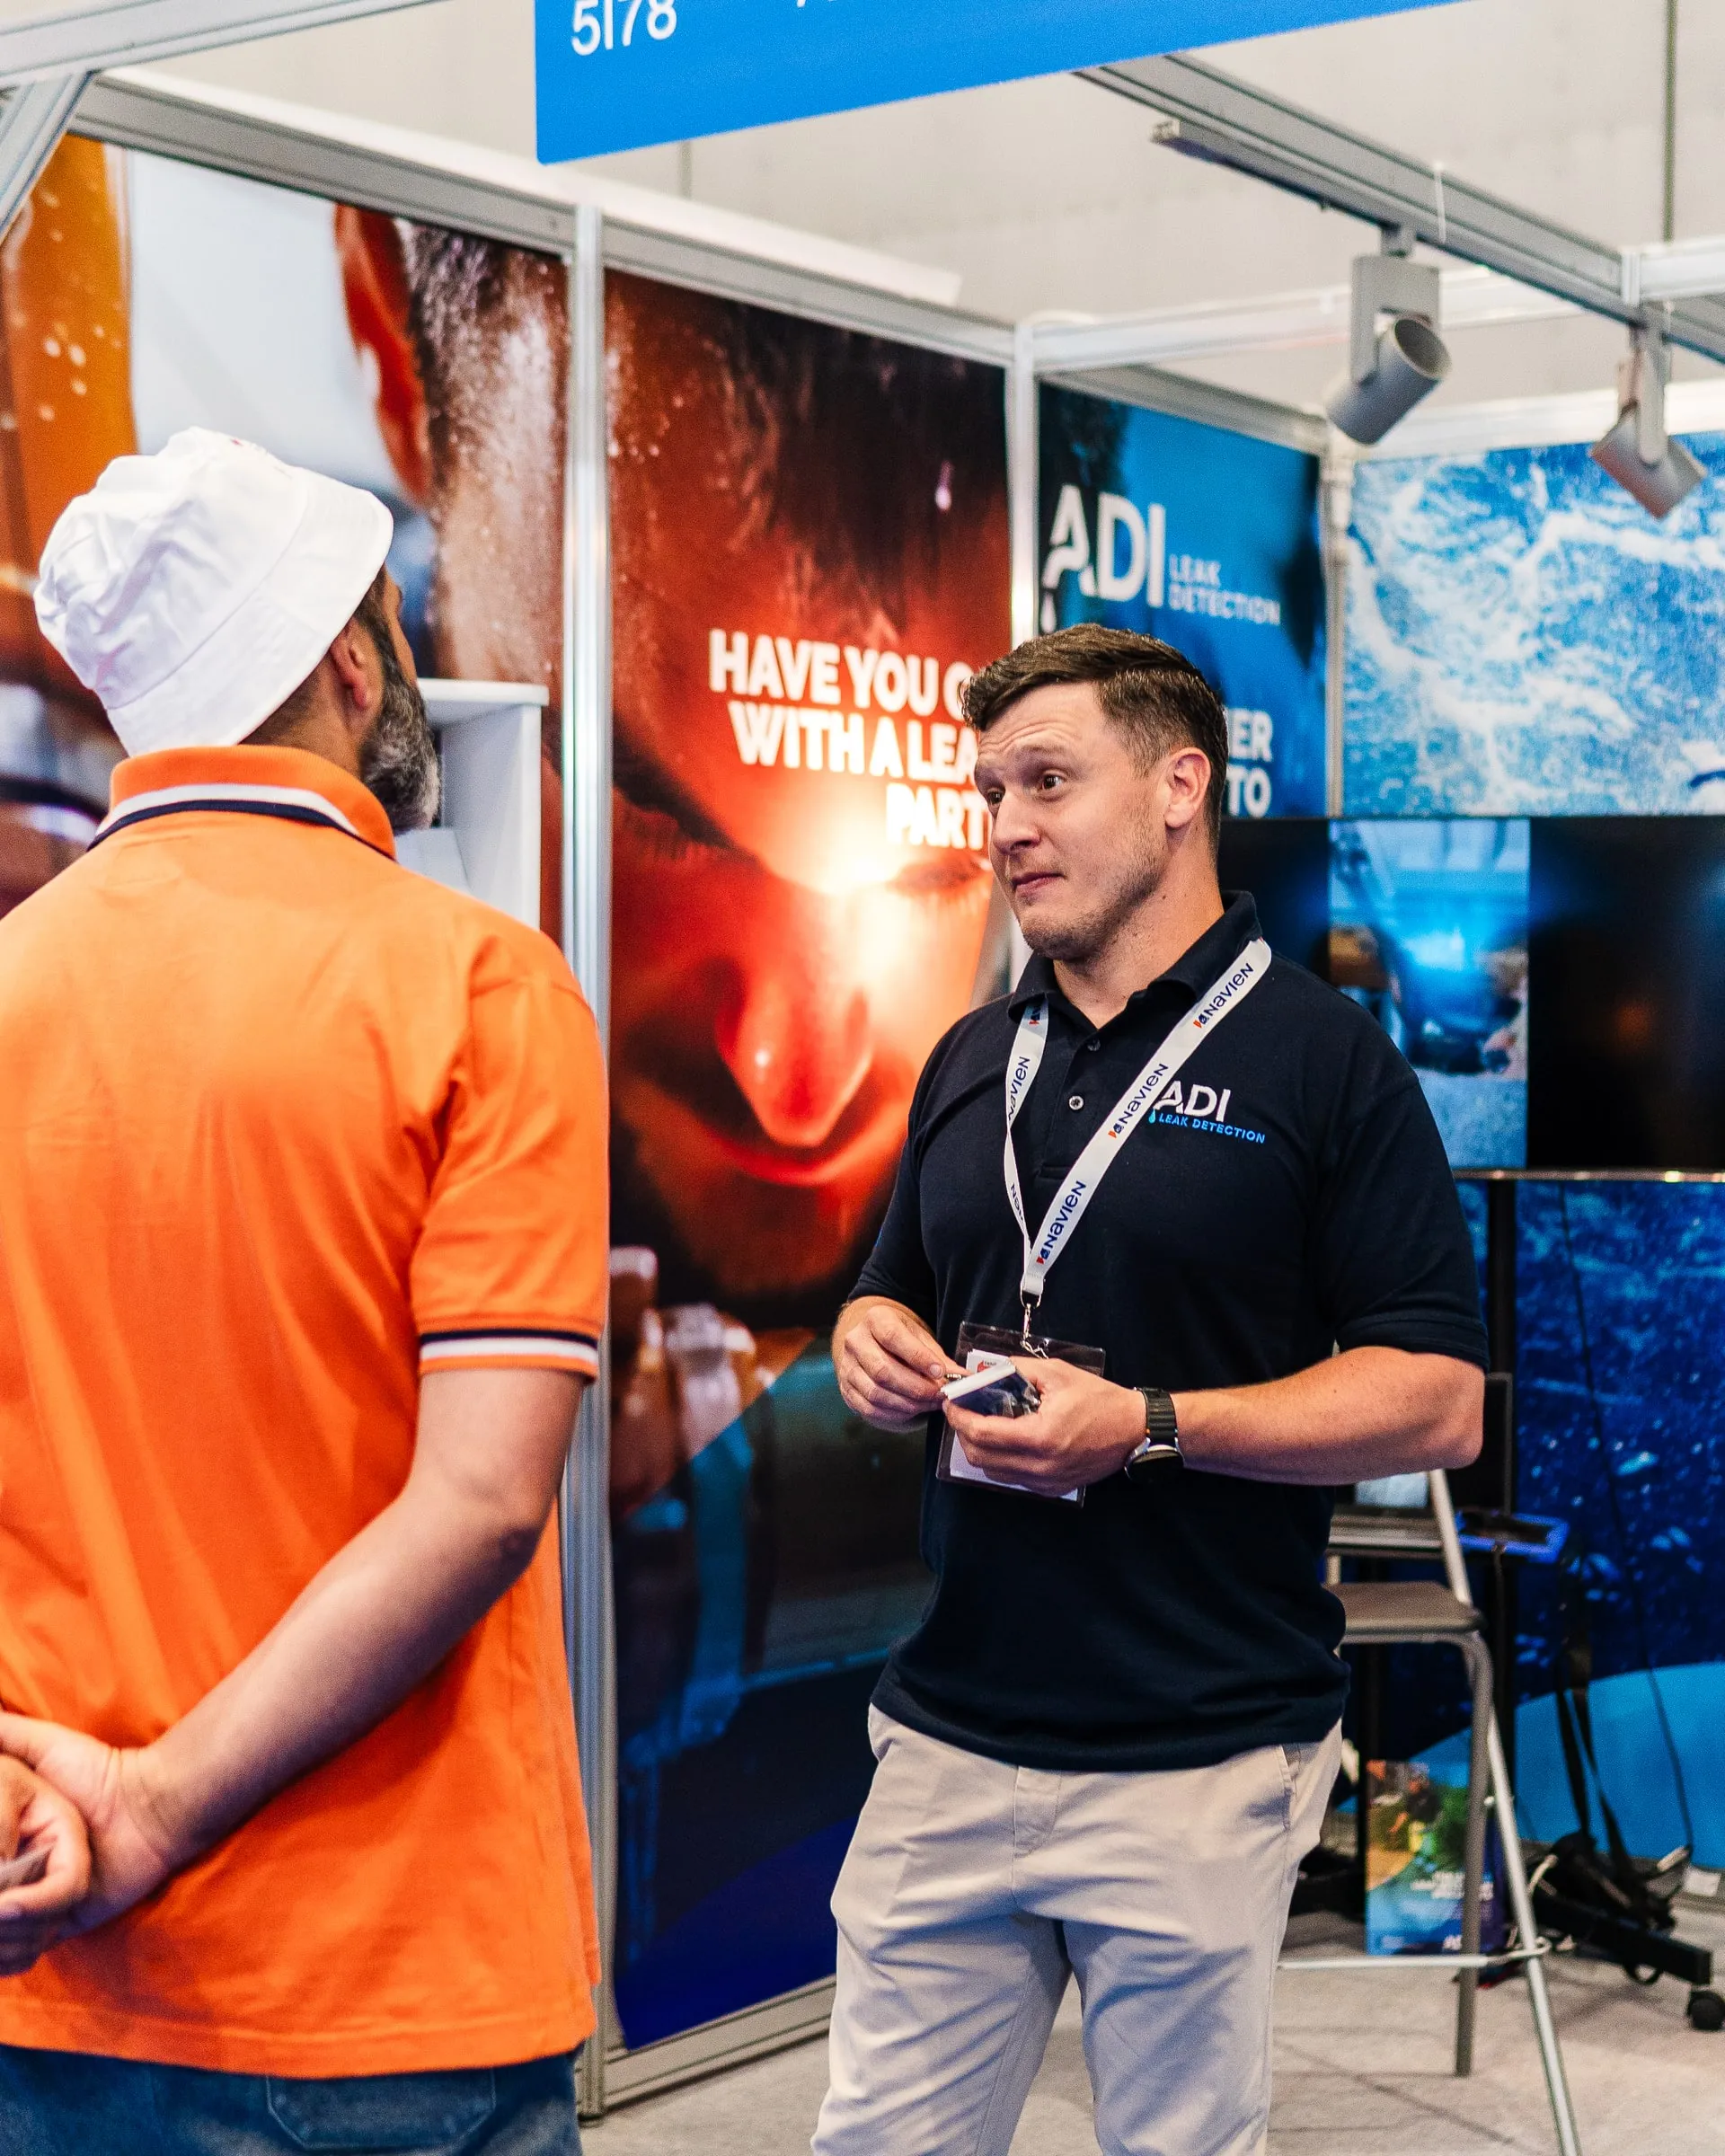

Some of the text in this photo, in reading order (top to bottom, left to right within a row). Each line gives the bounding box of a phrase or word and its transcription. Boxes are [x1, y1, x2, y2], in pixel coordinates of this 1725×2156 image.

[1042, 484, 1166, 609] ADI
[709, 629, 841, 705] HAVE
[844, 645, 939, 716] YOU
[727, 700, 978, 785] WITH A LEA
[1225, 705, 1273, 763] ER
[886, 782, 989, 850] PART
[1154, 1080, 1232, 1122] ADI
[1158, 1112, 1266, 1144] LEAK DETECTION
